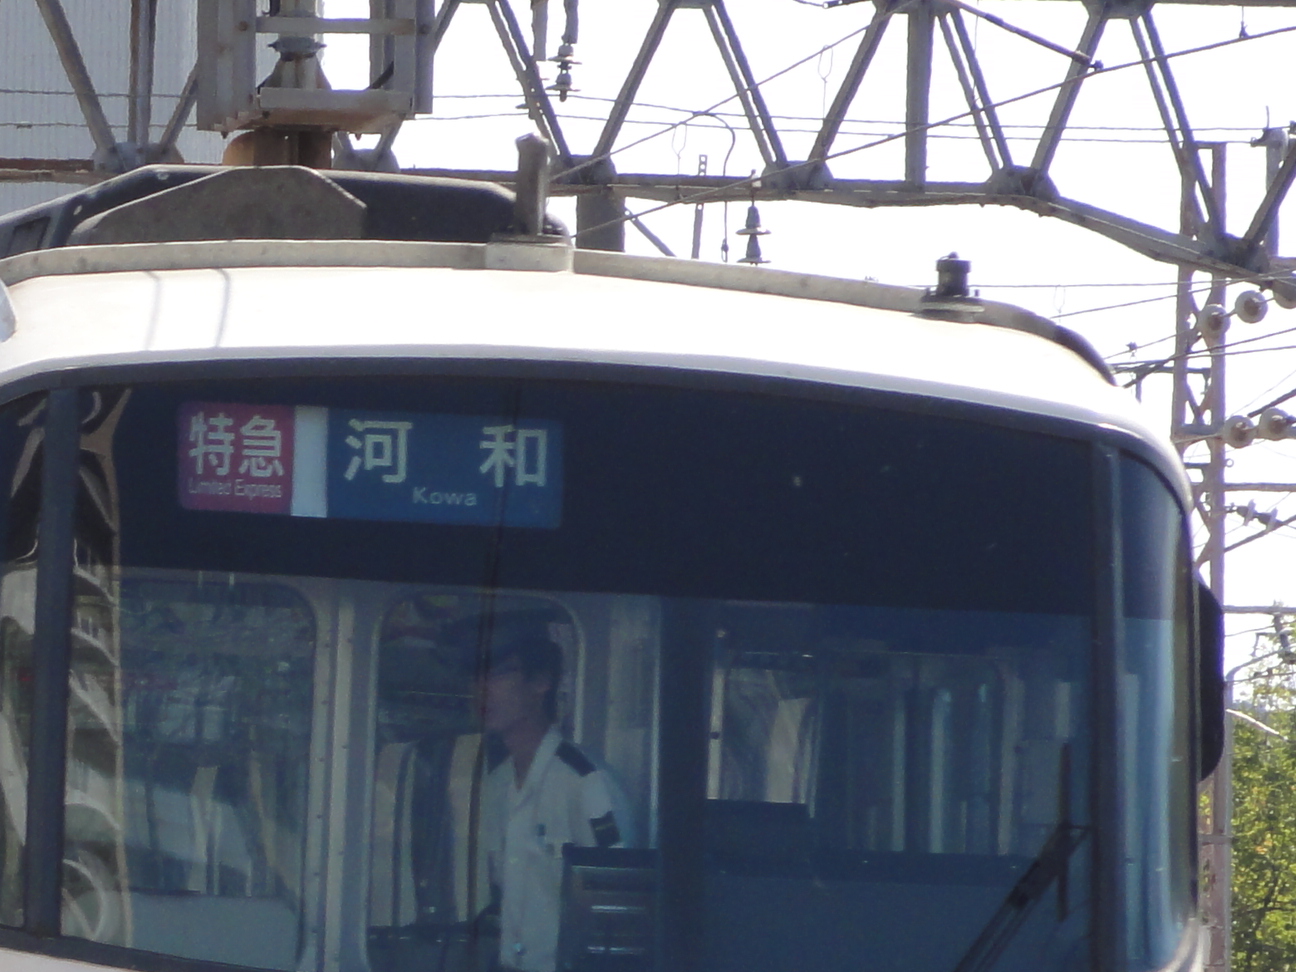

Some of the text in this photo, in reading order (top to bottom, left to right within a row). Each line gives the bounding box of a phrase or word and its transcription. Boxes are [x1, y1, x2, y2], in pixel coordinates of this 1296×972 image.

[189, 411, 285, 478] 特急
[235, 479, 283, 500] Express
[412, 486, 479, 507] Kowa
